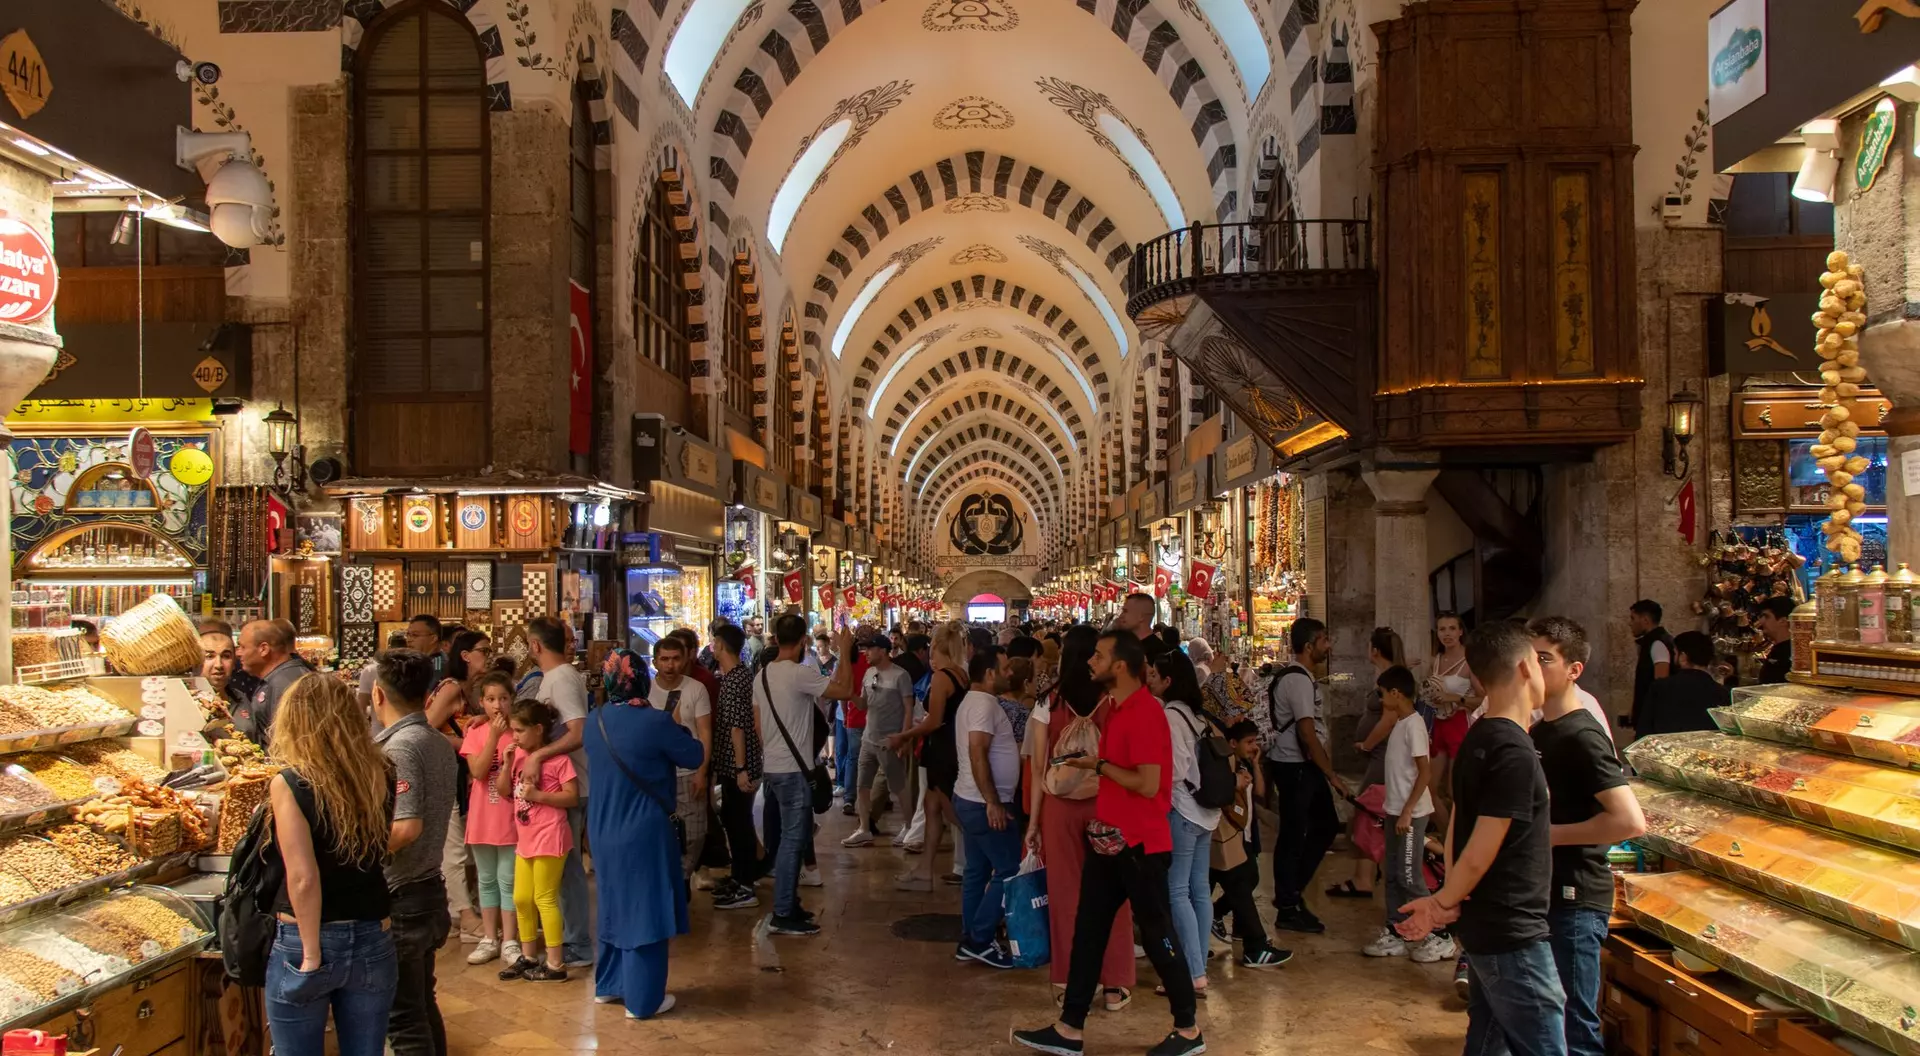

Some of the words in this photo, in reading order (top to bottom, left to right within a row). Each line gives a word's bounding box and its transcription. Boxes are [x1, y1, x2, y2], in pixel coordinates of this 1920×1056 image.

[1714, 38, 1759, 77] Arslanbaba
[8, 51, 42, 98] 44/1
[196, 367, 223, 382] 40/B
[1031, 894, 1049, 909] ma
